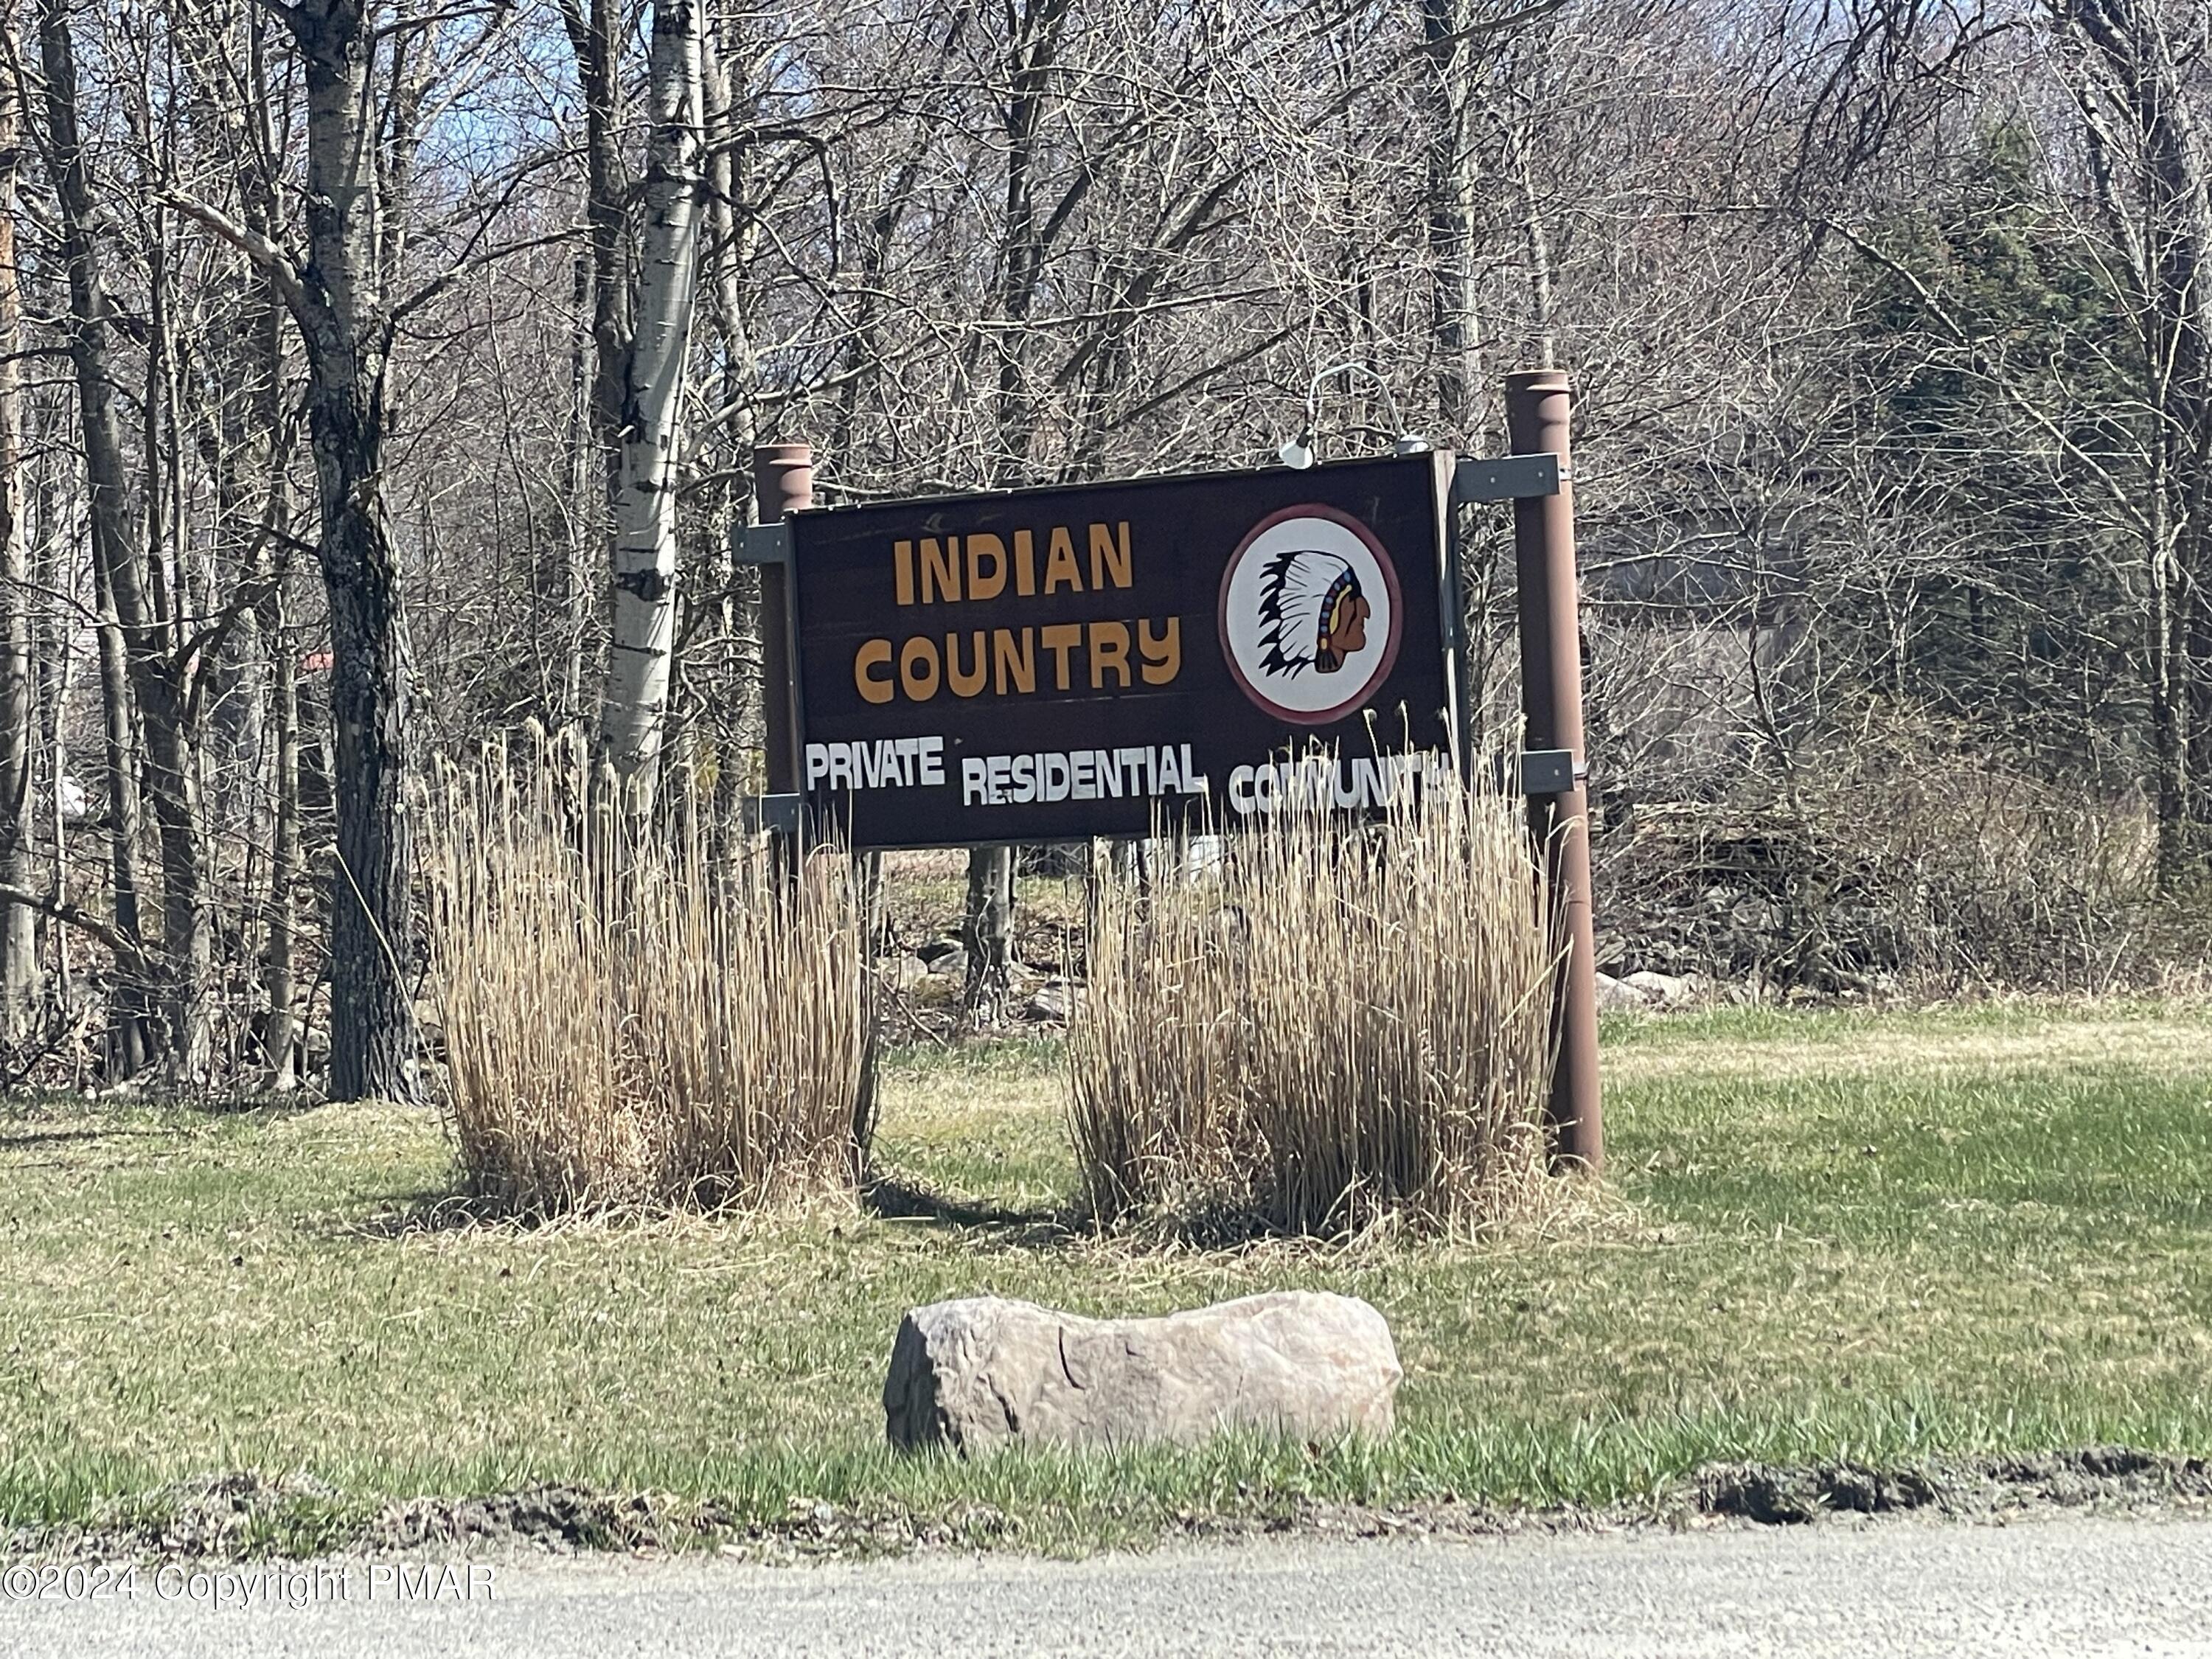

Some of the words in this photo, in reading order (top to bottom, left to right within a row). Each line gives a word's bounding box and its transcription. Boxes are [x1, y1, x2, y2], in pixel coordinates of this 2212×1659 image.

[894, 521, 1133, 605] INDIAN
[855, 617, 1180, 703] COUNTRY
[806, 737, 945, 790] PRIVATE
[962, 744, 1206, 805] RESIDENTIAL
